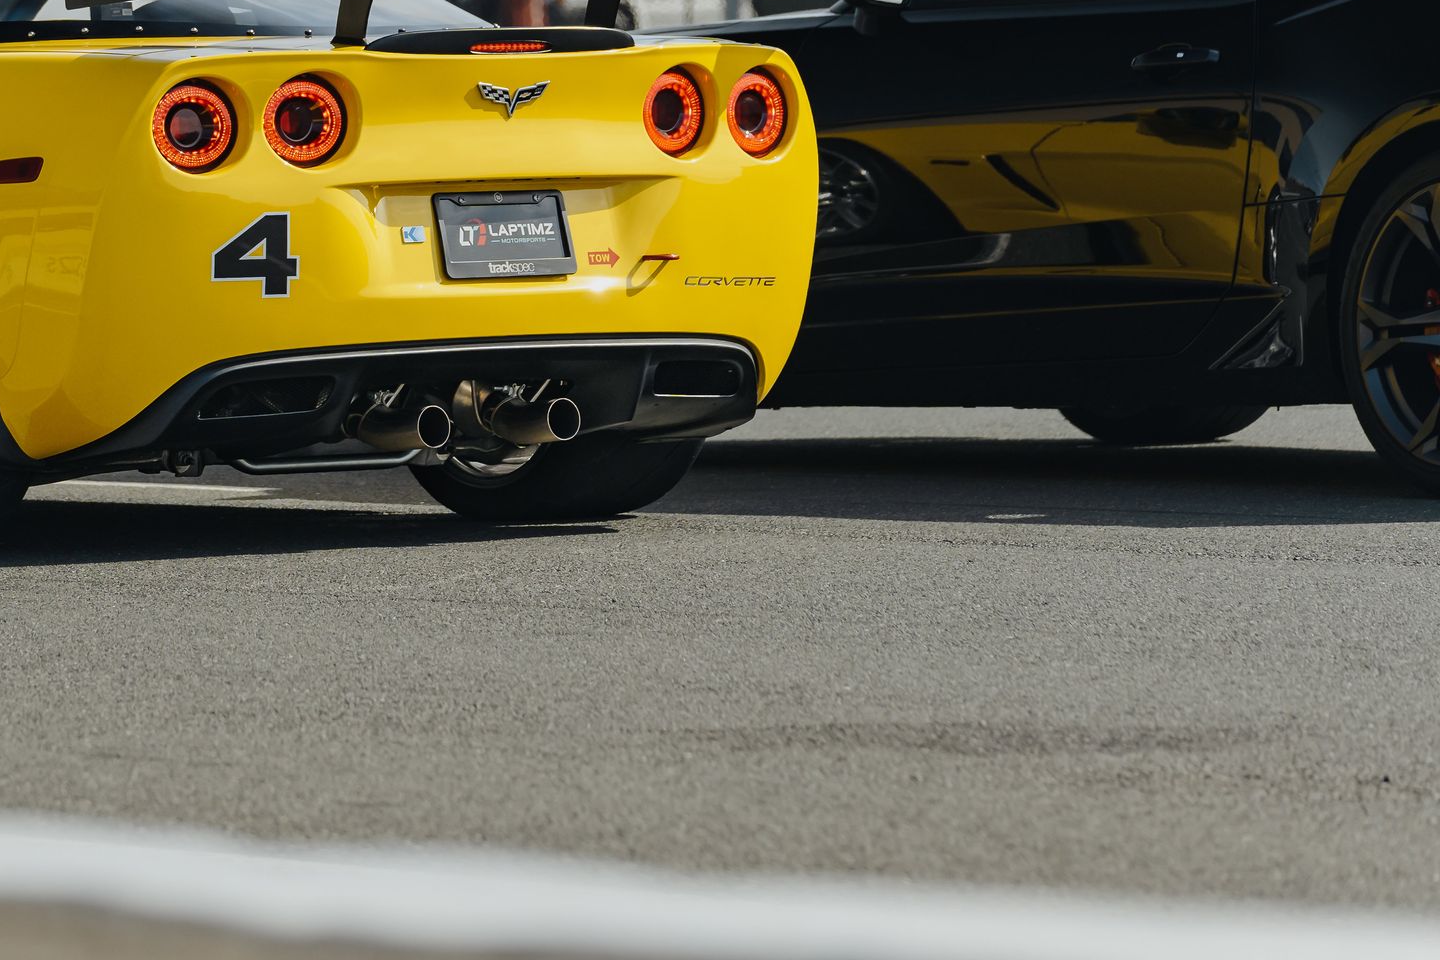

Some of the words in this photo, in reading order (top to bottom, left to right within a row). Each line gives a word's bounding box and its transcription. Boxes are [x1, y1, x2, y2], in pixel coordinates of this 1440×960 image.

[487, 223, 555, 237] LAPTIMZ
[210, 211, 300, 298] 4
[589, 253, 611, 264] TOW
[487, 261, 536, 275] trackspec
[684, 275, 776, 287] CORVETTE
